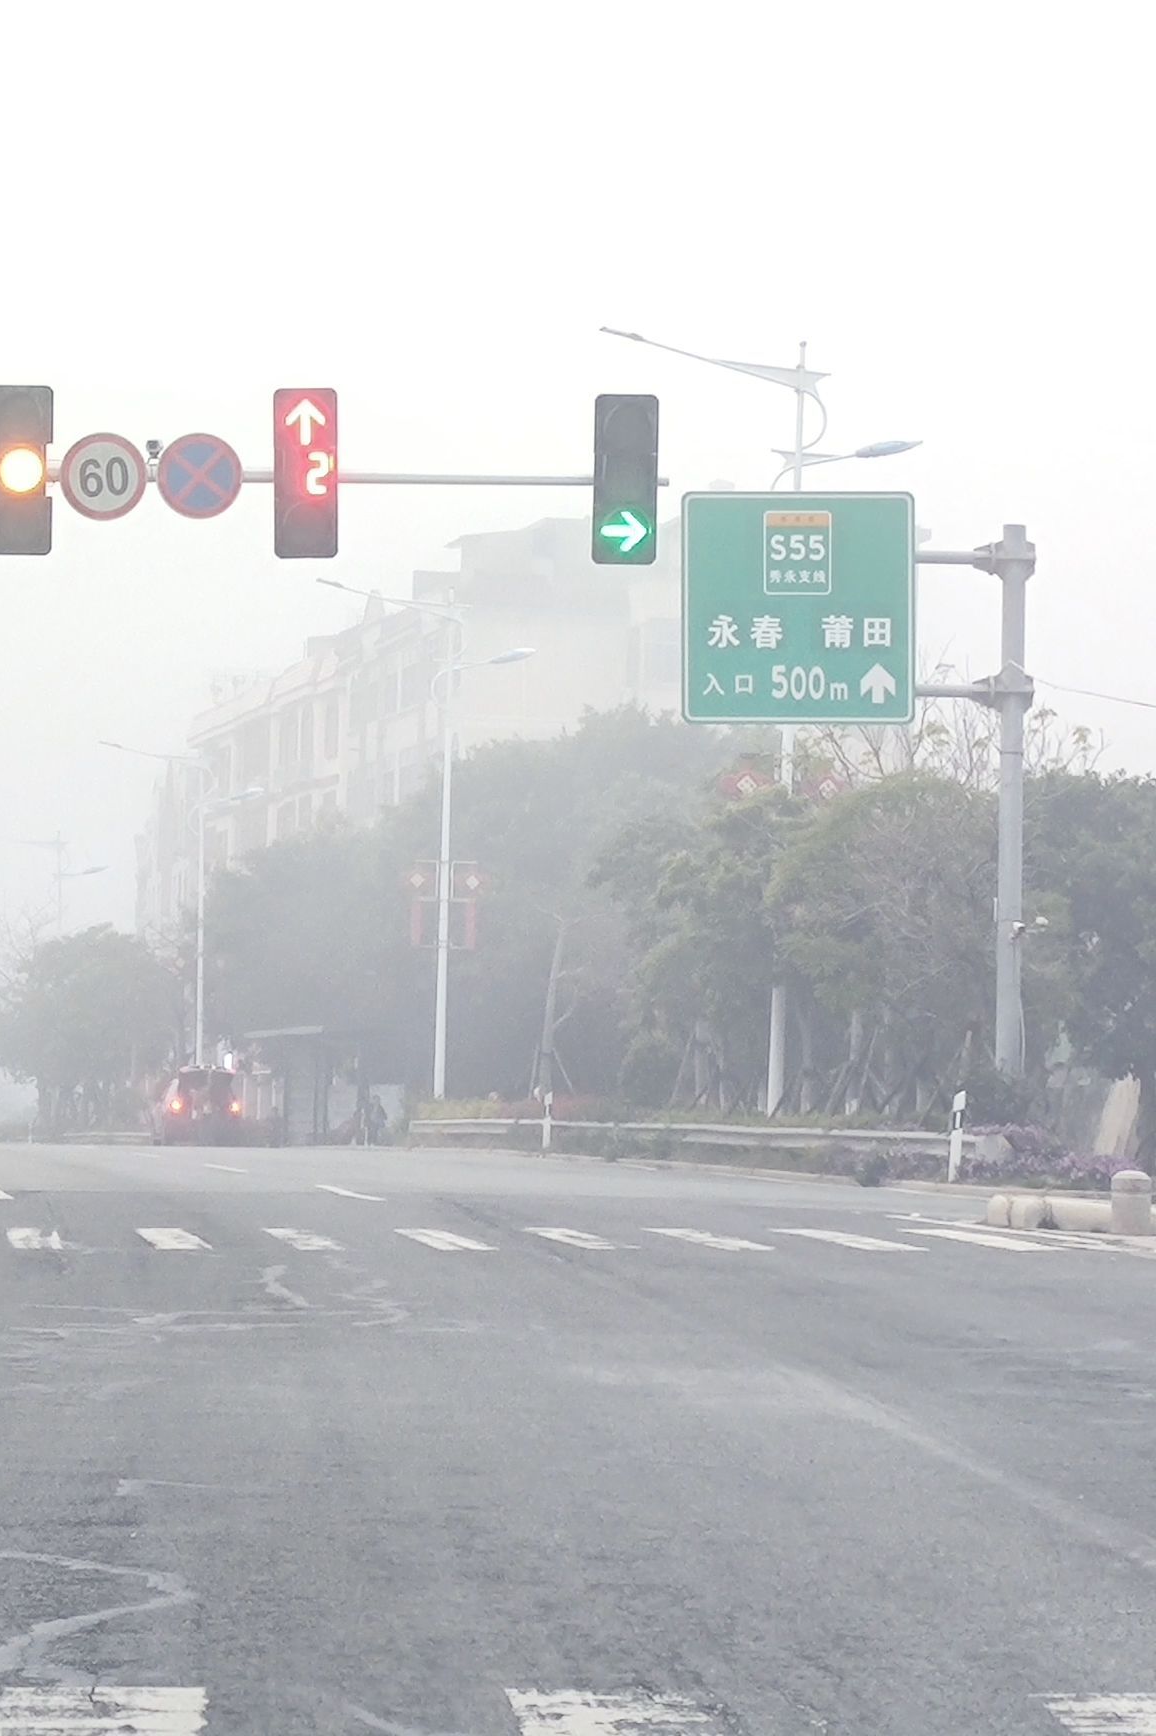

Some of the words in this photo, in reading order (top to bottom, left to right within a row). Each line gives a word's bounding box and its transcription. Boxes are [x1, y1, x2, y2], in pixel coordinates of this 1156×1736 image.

[78, 456, 130, 498] 60
[305, 451, 332, 496] 2
[770, 534, 826, 561] S55
[707, 614, 784, 650] 永春
[821, 614, 892, 649] 莆田
[702, 672, 755, 696] 入口
